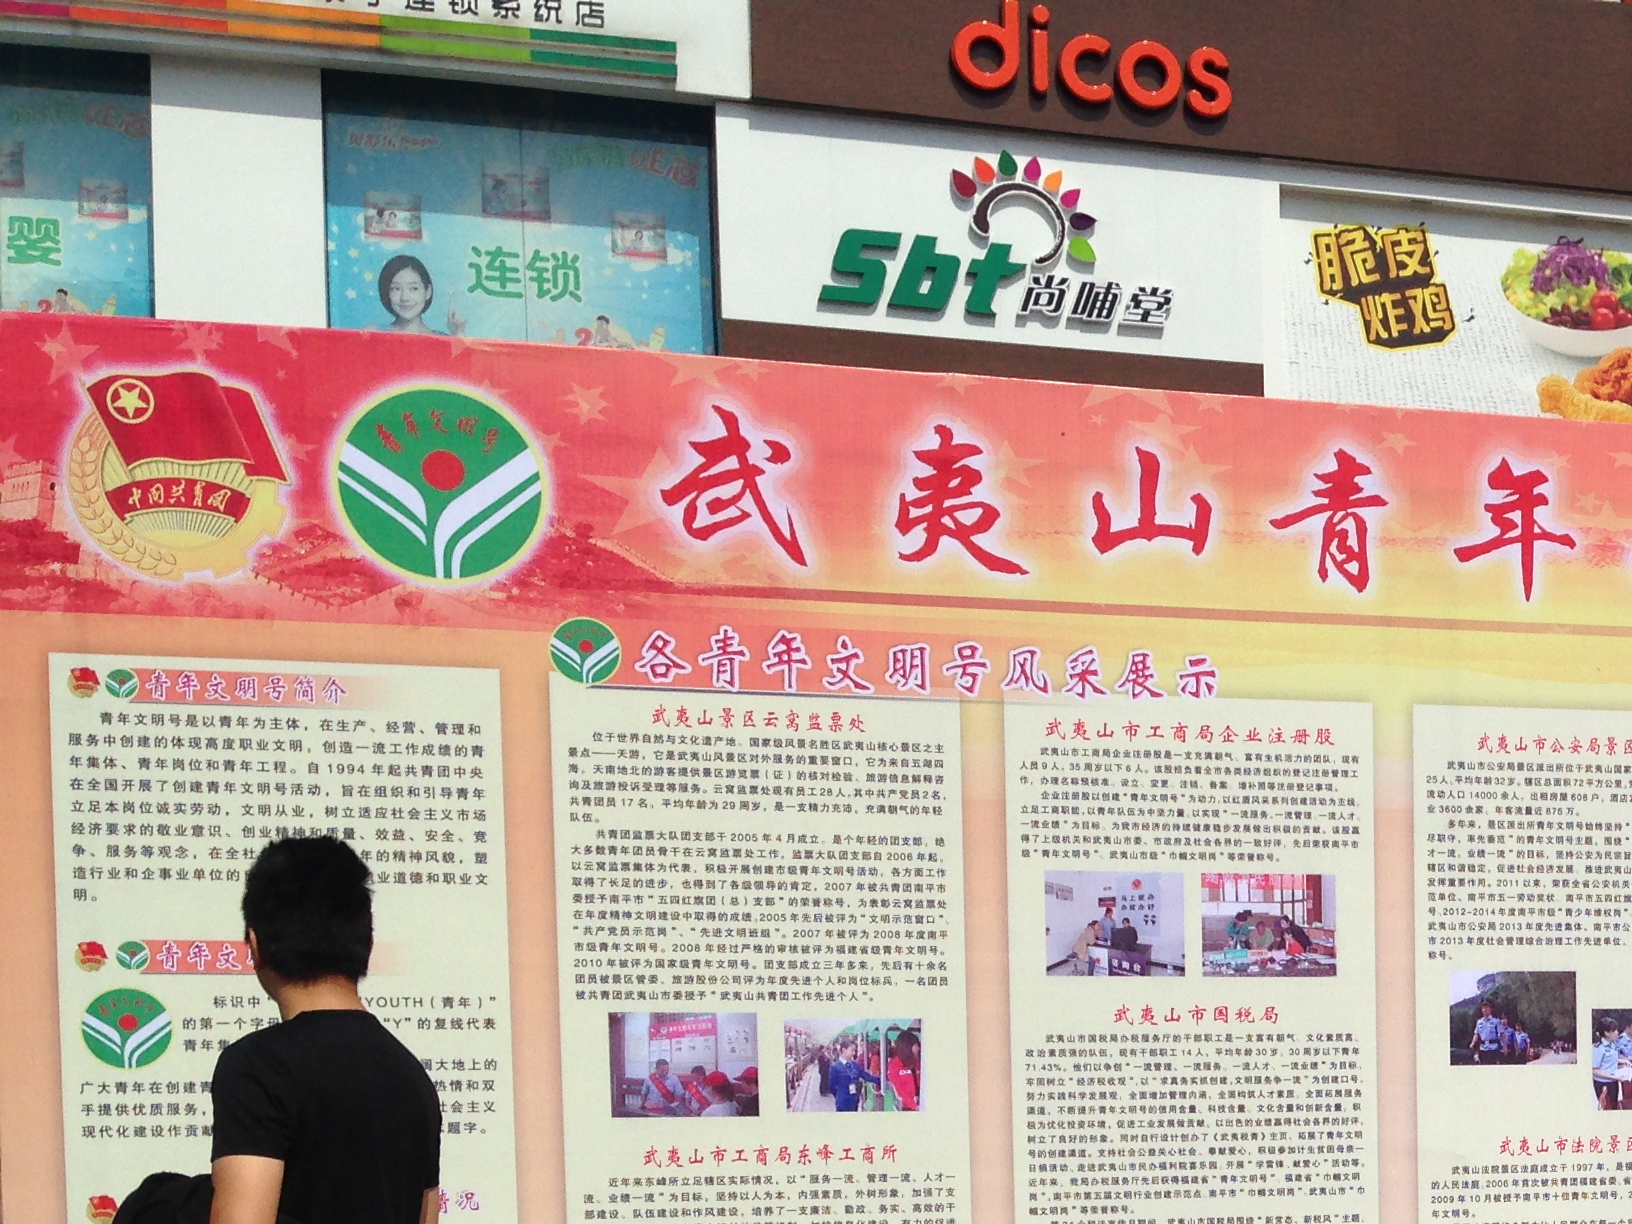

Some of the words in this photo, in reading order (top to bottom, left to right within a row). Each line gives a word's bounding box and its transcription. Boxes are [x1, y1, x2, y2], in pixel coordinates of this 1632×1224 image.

[951, 0, 1233, 118] dicos
[467, 245, 583, 303] 连锁
[817, 228, 1028, 317] Sbt
[1019, 274, 1174, 330] 尚哺堂
[1313, 227, 1432, 290] 脆皮
[1361, 283, 1454, 342] 炸鸡
[146, 672, 349, 704] 青年文明号简介
[634, 625, 1218, 699] 各青年文明号风采展示
[651, 704, 866, 733] 武夷山景区云窝监票处
[1045, 721, 1336, 746] 武夷山市工商局企业注册股
[1113, 1003, 1281, 1026] 武夷山市国税局
[642, 1144, 899, 1168] 武夷山市工商局东峰工商所
